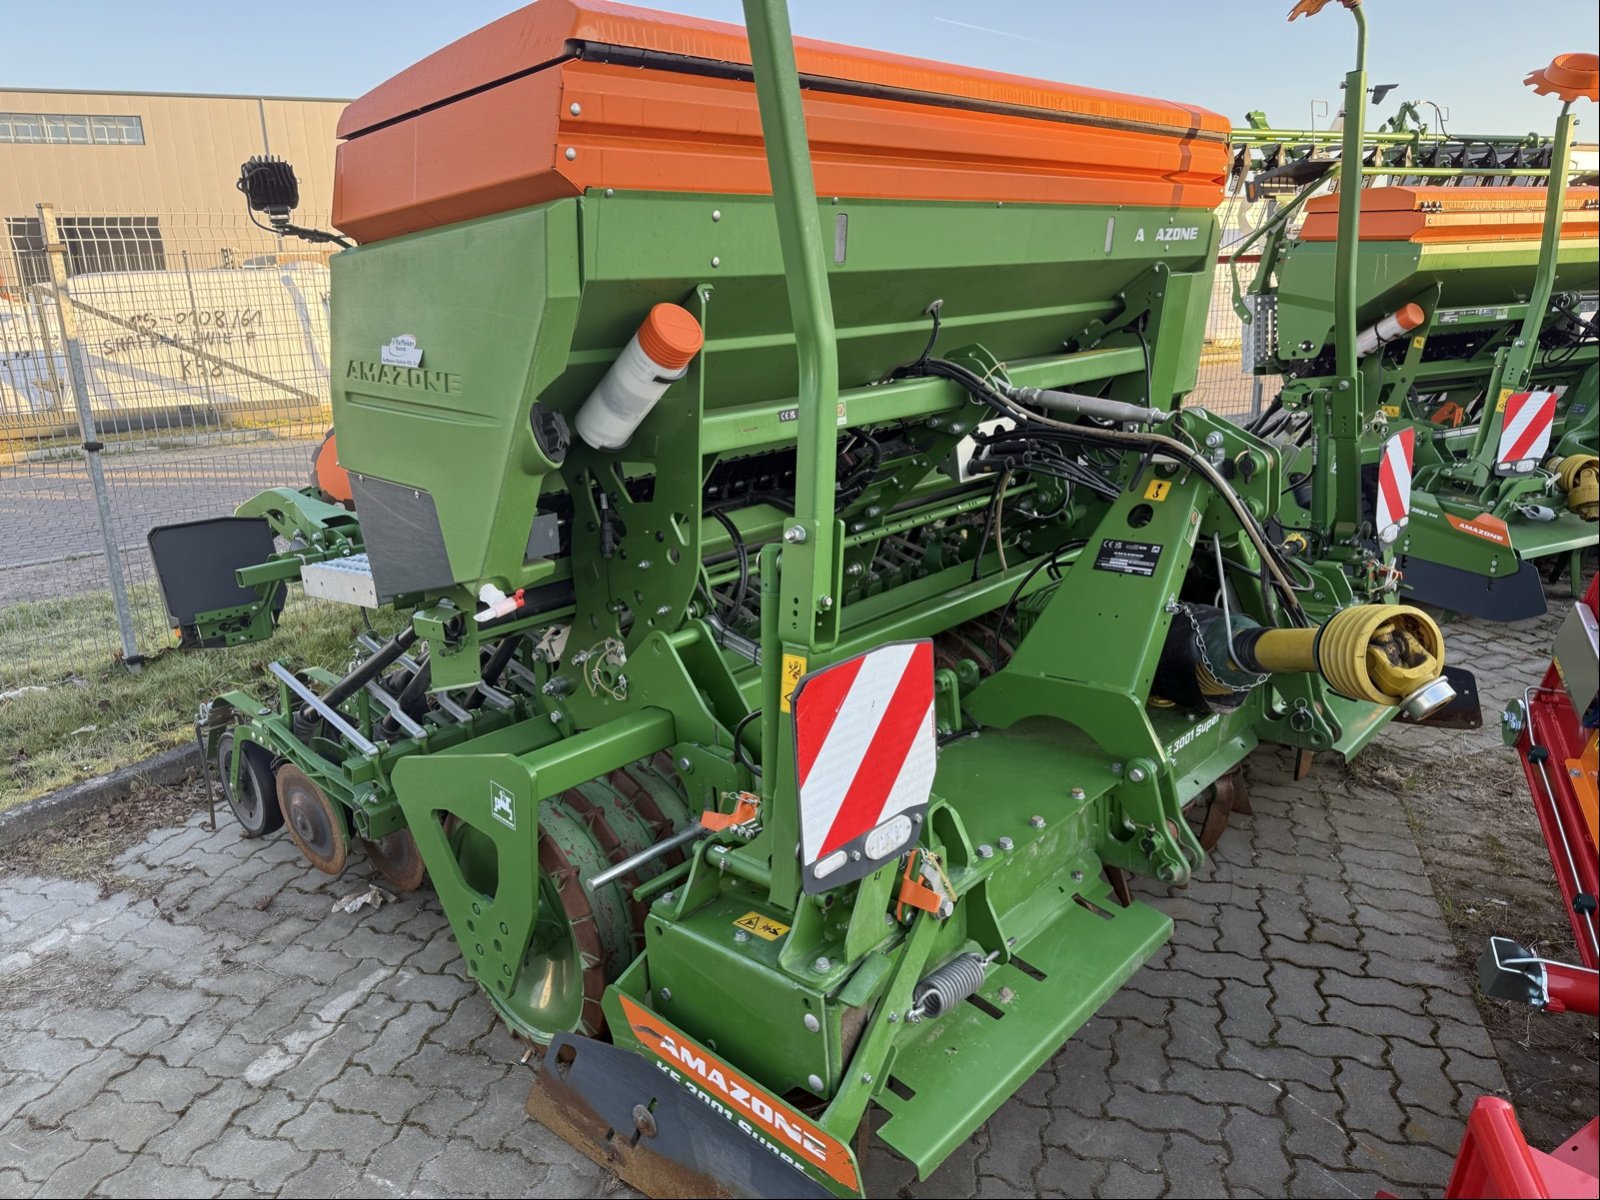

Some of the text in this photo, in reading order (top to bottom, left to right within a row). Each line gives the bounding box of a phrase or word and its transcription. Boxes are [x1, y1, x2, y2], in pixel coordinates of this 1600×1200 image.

[1134, 227, 1199, 242] AAZONE
[346, 360, 462, 394] AMAZONE
[1458, 522, 1504, 542] AMAZONE
[1173, 728, 1195, 754] 3001
[1195, 713, 1220, 737] Super
[659, 1035, 827, 1162] AMAZONE
